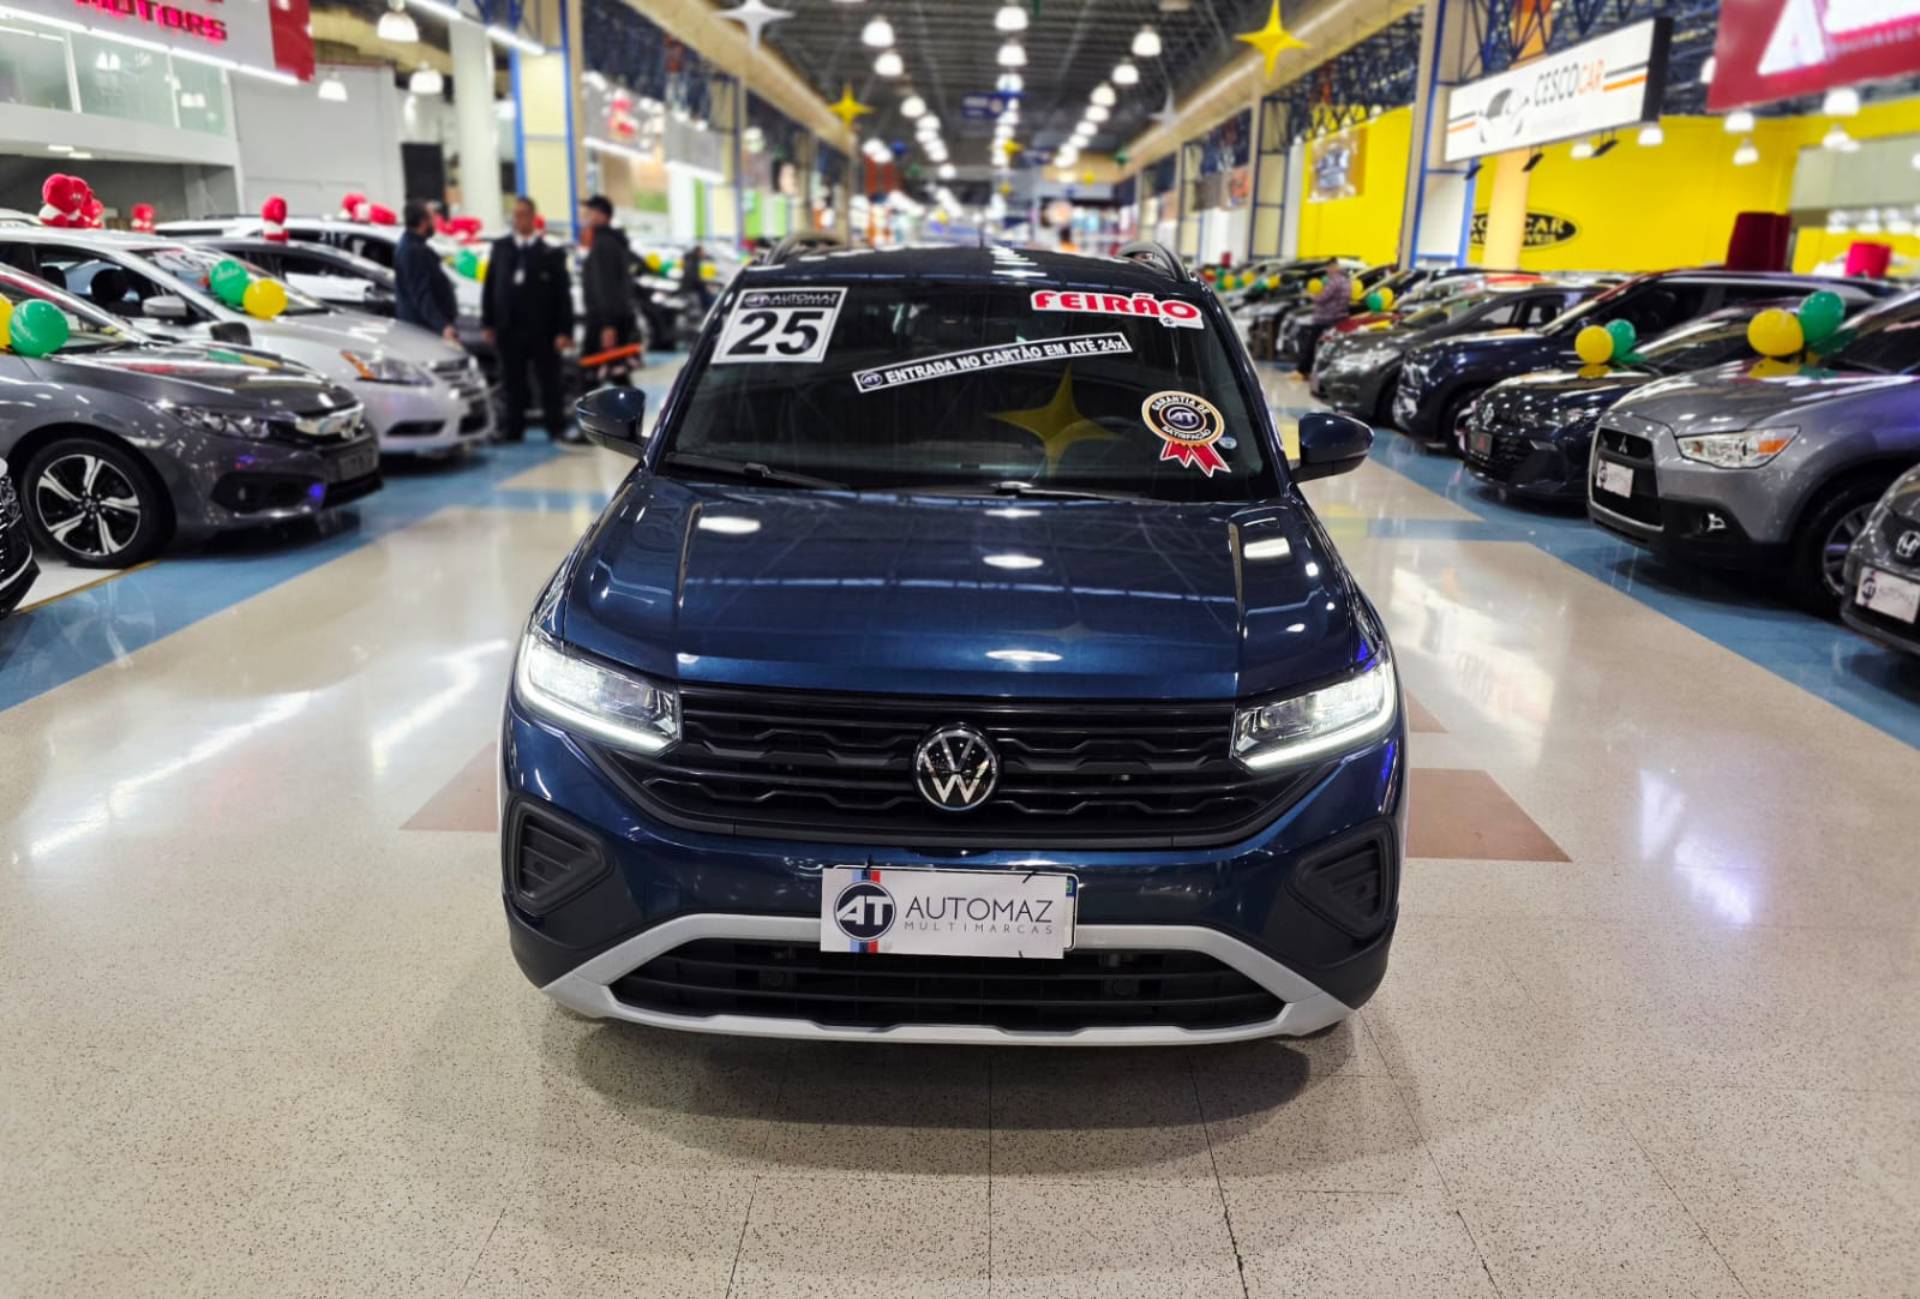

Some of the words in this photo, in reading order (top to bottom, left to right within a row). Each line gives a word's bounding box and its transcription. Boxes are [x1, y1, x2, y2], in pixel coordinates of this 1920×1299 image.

[1034, 292, 1198, 319] FEIRÃO
[726, 310, 825, 355] 25
[884, 359, 957, 384] ENTRADA
[956, 355, 981, 370] NO
[981, 345, 1042, 365] CARTÃO
[1043, 343, 1068, 356] EM
[1069, 338, 1098, 355] ATÉ
[836, 894, 893, 927] AT
[904, 896, 1054, 924] AUTOMAZ
[904, 921, 1053, 935] MULTIMARCAS
